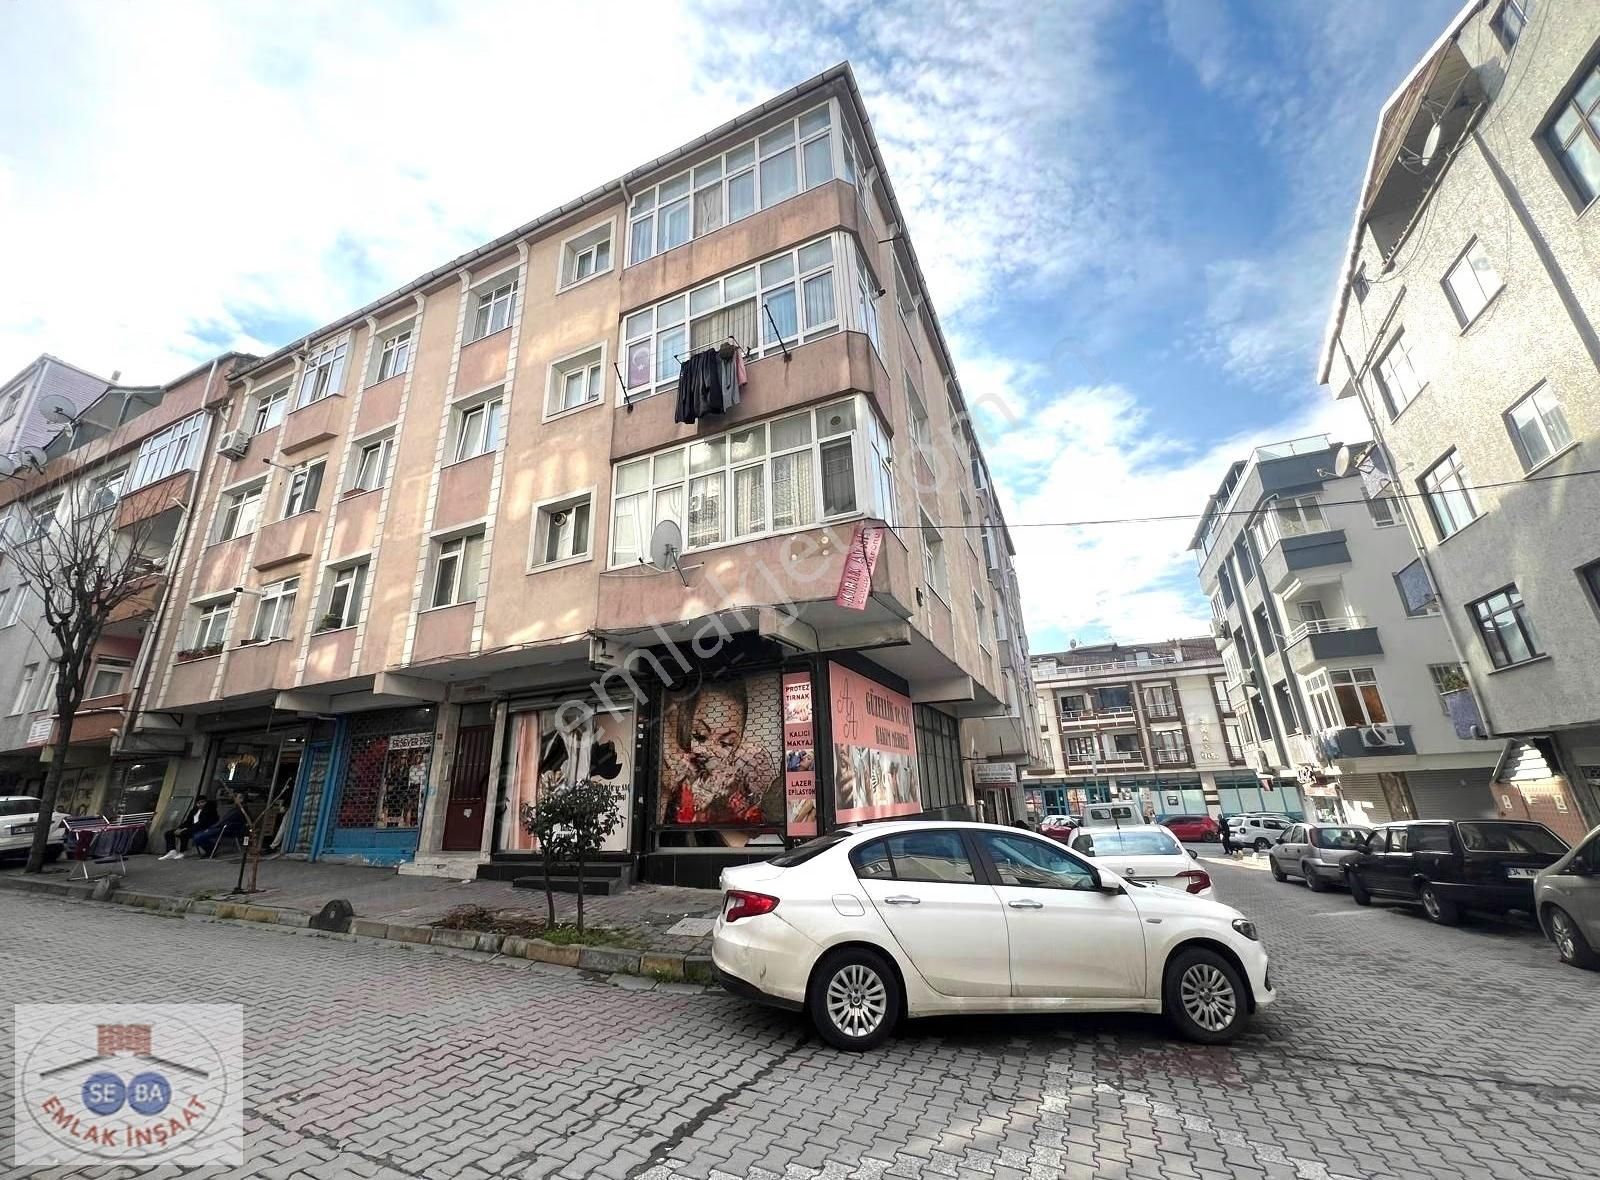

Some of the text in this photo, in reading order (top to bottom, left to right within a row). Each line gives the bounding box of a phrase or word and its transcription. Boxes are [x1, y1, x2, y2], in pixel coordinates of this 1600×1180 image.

[785, 684, 810, 693] PROTEZ
[786, 693, 810, 701] TIRNAK
[789, 730, 810, 738] KALICI
[786, 739, 813, 747] MAKYAJ
[791, 779, 812, 787] LAZER
